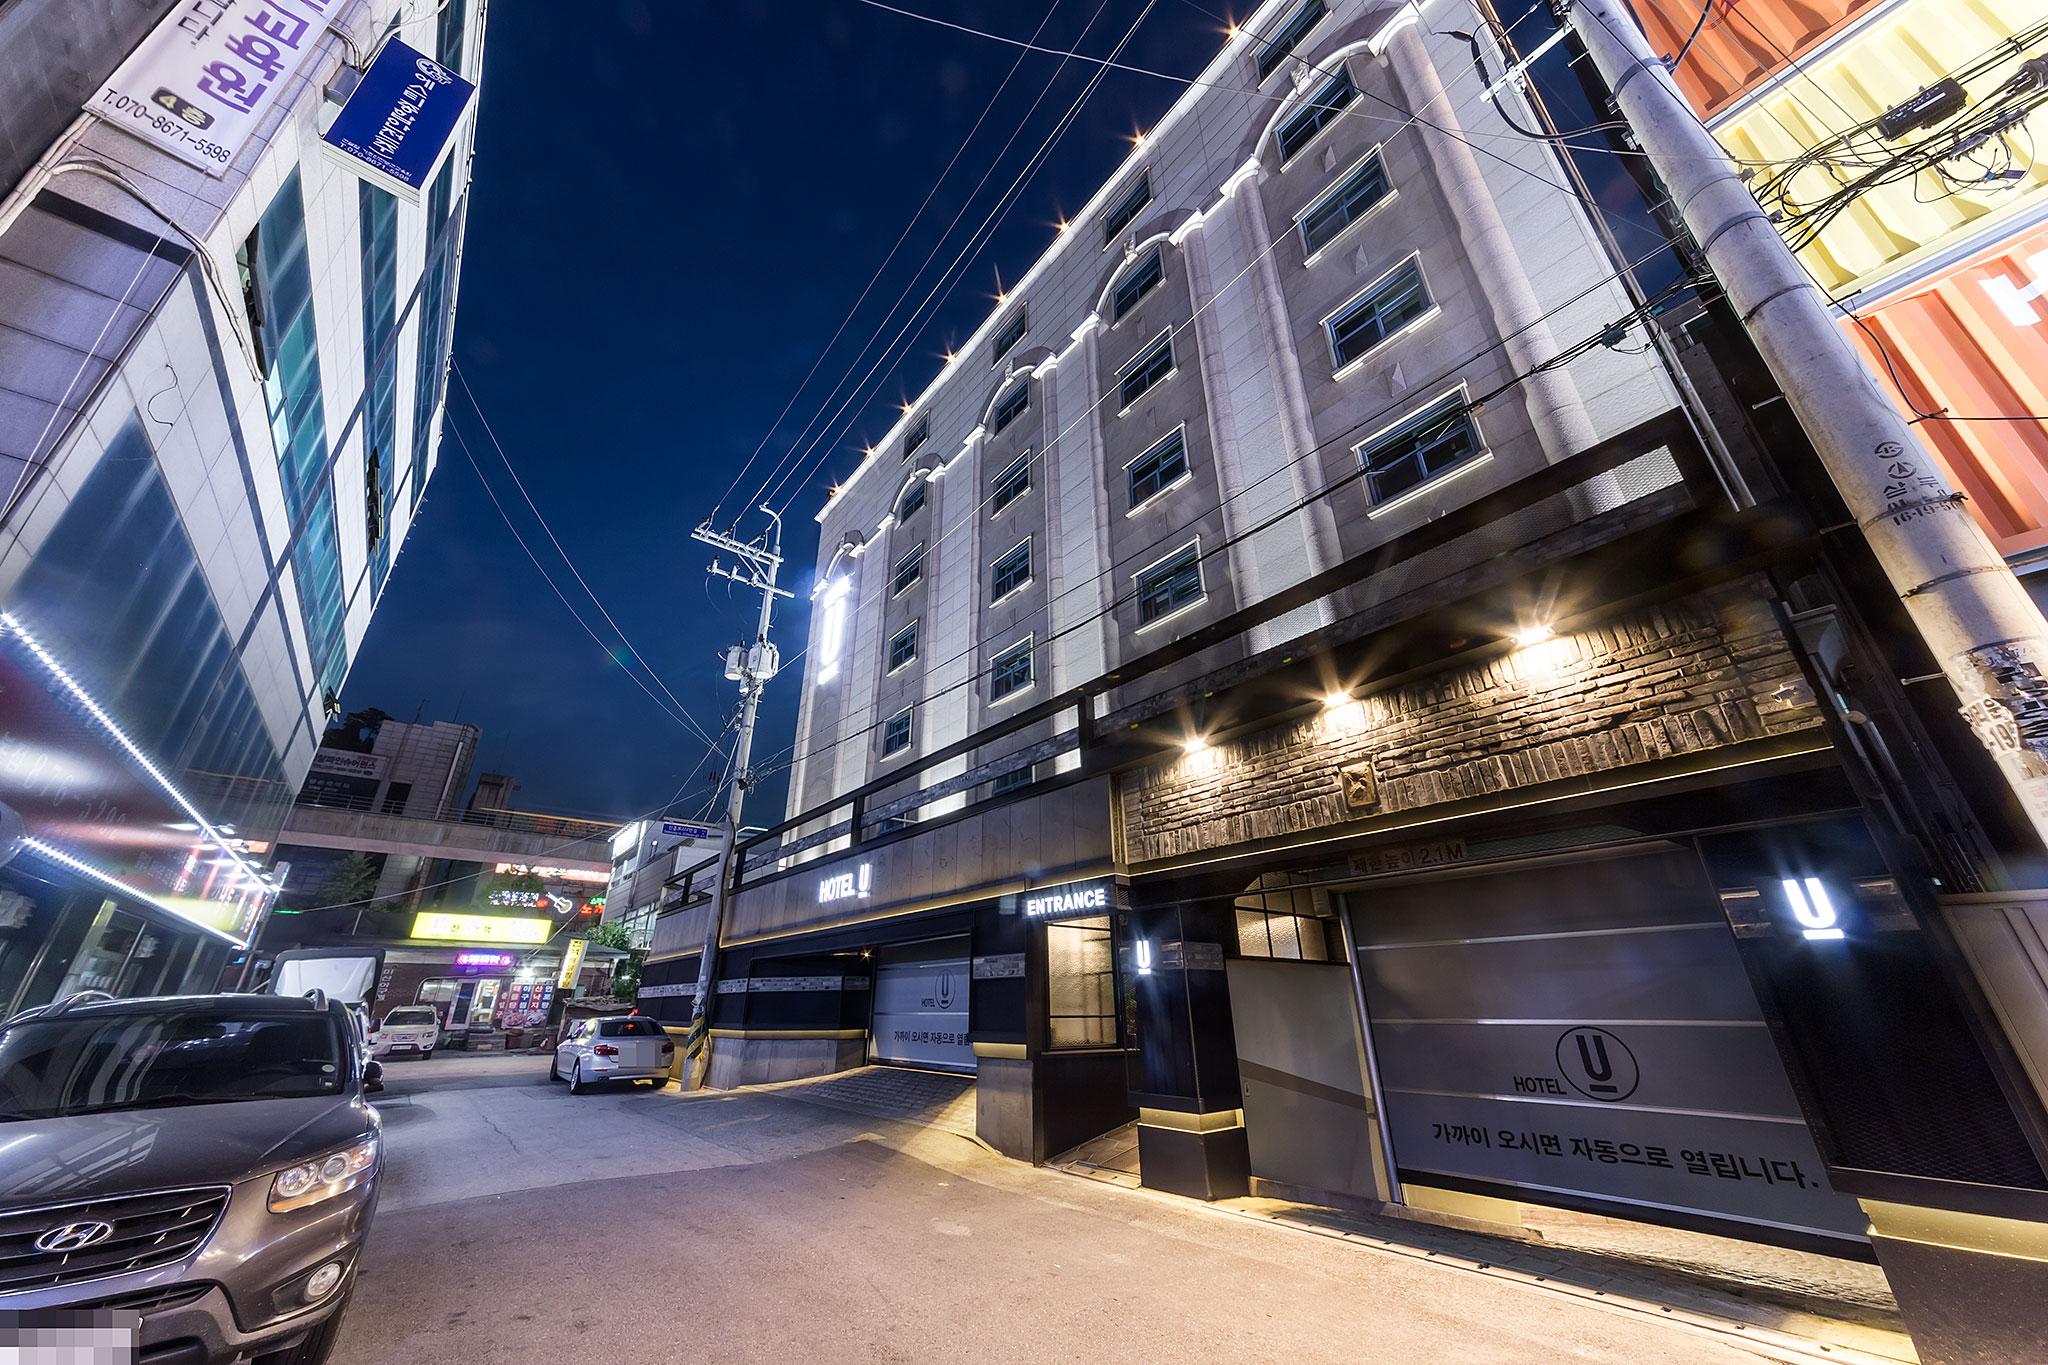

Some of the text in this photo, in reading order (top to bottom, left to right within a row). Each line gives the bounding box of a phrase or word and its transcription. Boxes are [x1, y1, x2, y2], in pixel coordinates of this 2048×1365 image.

[197, 0, 330, 114] 교육원
[819, 863, 871, 903] HOTEL U
[1027, 888, 1106, 916] ENTRANCE
[1782, 877, 1845, 940] U
[1136, 940, 1152, 975] U
[920, 998, 936, 1008] HOTEL
[894, 1031, 911, 1042] 가까이
[911, 1031, 928, 1043] 오시면
[930, 1032, 955, 1045] 자동으로
[1513, 1076, 1567, 1096] HOTEL
[1432, 1122, 1820, 1190] 가까이 오시면 자동으로 열립니다.
